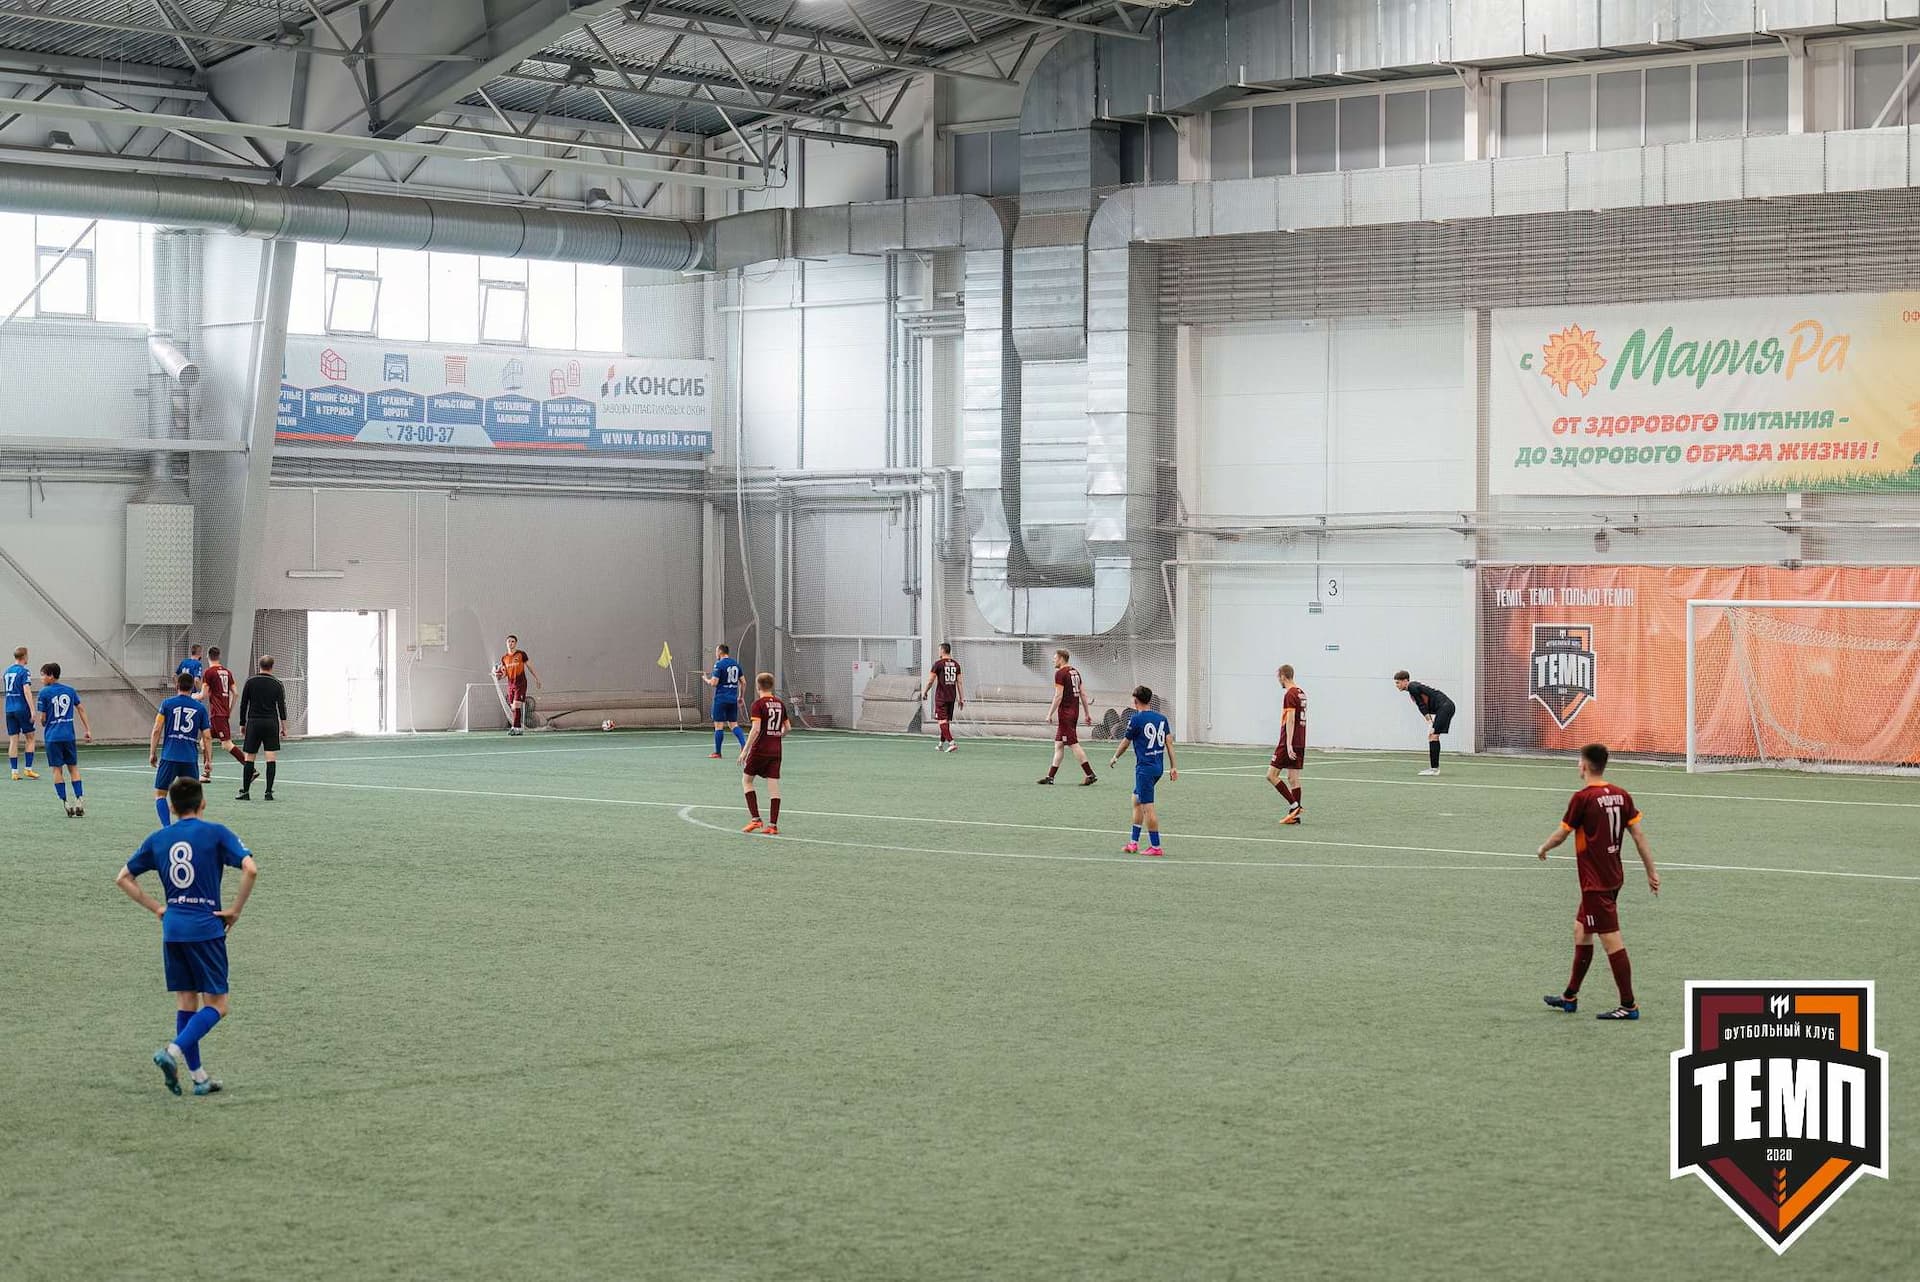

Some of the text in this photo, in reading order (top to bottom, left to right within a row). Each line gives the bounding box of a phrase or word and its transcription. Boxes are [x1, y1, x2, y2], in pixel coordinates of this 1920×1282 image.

[625, 376, 705, 396] КОНСИБ
[397, 424, 455, 443] 73-00-37
[1552, 416, 1582, 434] ОТ
[1584, 413, 1719, 437] ЗДОРОВОГО
[1723, 410, 1835, 431] ПИТАНИЯ
[601, 431, 707, 446] www.konsib.com
[1514, 446, 1547, 468] ДО
[1549, 445, 1682, 467] ЗДОРОВОГО
[1685, 443, 1772, 463] ОБРАЗА
[1328, 579, 1338, 597] 3
[1560, 587, 1600, 606] ТОЛЬКО
[4, 672, 17, 692] 17
[726, 666, 739, 684] 10
[1535, 653, 1591, 690] ТЕМП
[51, 693, 71, 718] 19
[173, 706, 197, 734] 13
[766, 708, 782, 731] 27
[1143, 721, 1166, 750] 96
[1605, 806, 1621, 845] 11
[169, 840, 195, 890] 8
